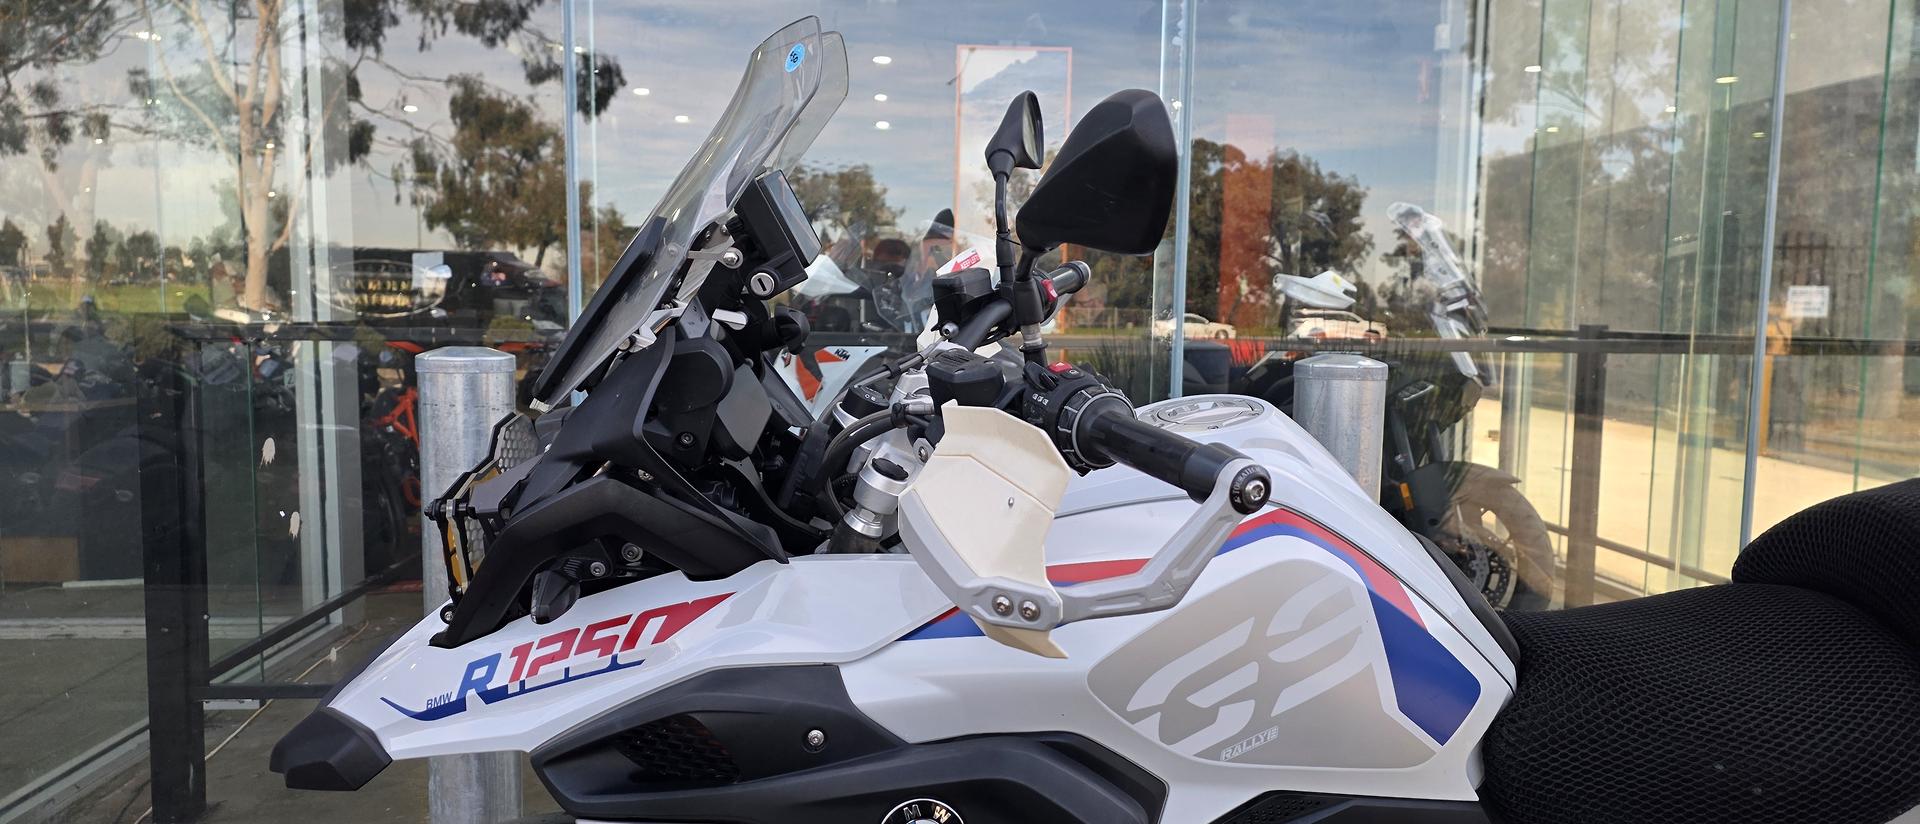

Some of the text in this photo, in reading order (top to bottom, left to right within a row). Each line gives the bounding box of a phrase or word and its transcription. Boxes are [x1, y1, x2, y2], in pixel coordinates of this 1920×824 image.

[834, 348, 851, 361] KTM
[426, 691, 453, 710] BMW
[456, 652, 502, 707] R
[1221, 725, 1279, 762] RALLYE
[903, 804, 952, 824] MW
